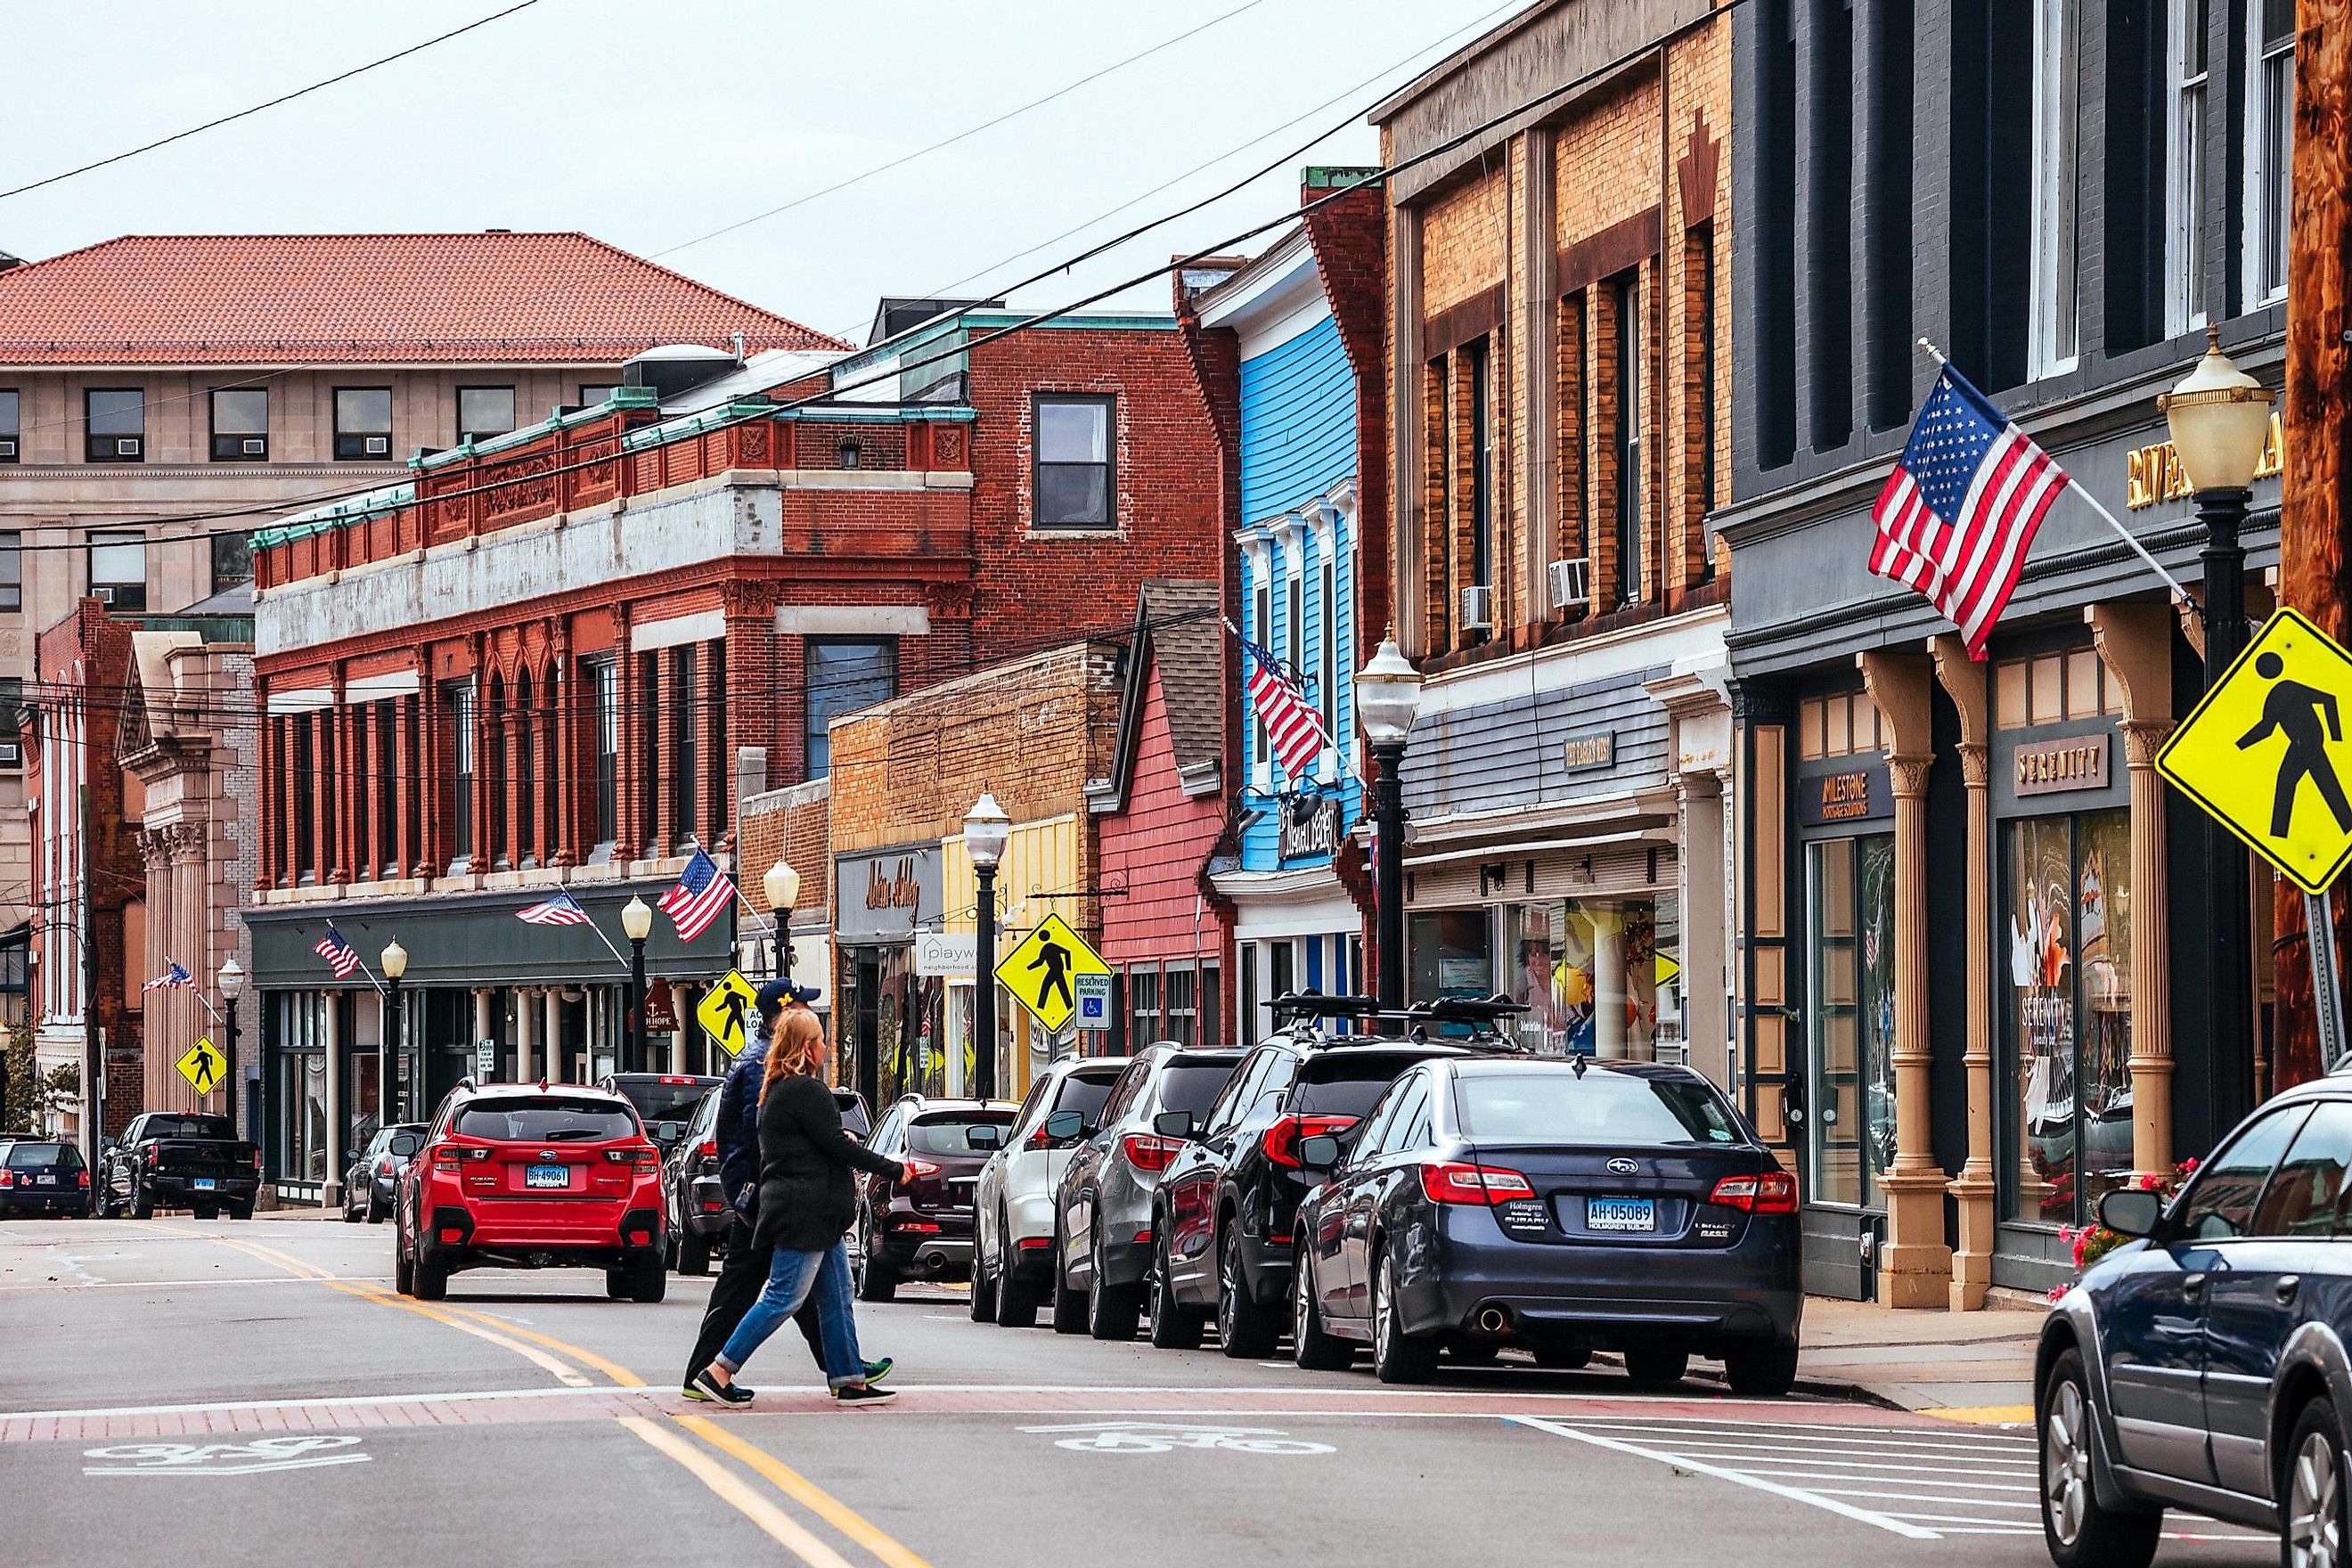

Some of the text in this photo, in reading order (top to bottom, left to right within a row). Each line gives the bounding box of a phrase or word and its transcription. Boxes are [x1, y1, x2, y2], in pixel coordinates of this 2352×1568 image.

[2018, 746, 2100, 784] SERENITY
[1822, 772, 1868, 803] MILESTONE
[929, 947, 975, 961] playw
[1076, 978, 1109, 986] RESERVED
[1079, 988, 1107, 997] PARKING
[2021, 997, 2066, 1027] SERENITY
[652, 1017, 672, 1025] HOPE
